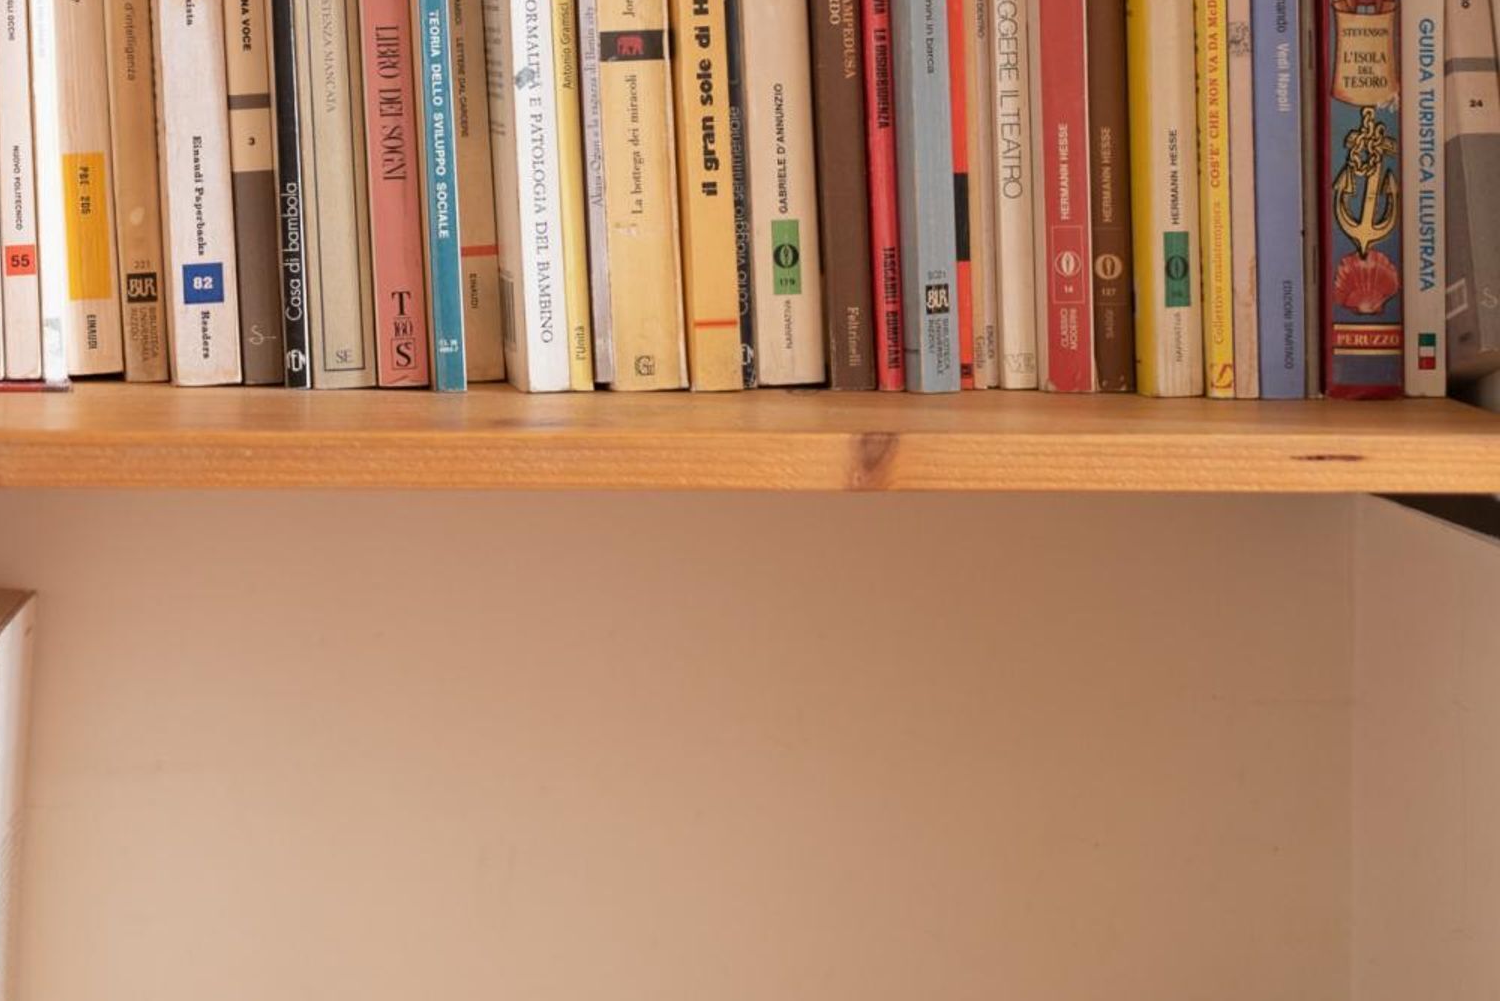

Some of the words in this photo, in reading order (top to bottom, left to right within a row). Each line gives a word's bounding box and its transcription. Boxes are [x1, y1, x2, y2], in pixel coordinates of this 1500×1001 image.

[241, 20, 252, 51] VOCE
[375, 26, 401, 78] LIBRO
[428, 11, 441, 57] TEORIA
[696, 27, 712, 49] di
[1342, 28, 1389, 37] STEVENSON
[1418, 19, 1434, 81] GUIDA
[1277, 43, 1289, 69] Vedi
[1343, 52, 1386, 64] L'ISOLA
[379, 89, 403, 117] DEI
[430, 64, 443, 106] DELLO
[529, 98, 542, 106] E
[697, 59, 714, 105] sole
[1000, 90, 1020, 106] IL
[1277, 73, 1290, 112] Napoli
[1343, 76, 1388, 88] TESORO
[774, 84, 785, 154] D'ANNUNZIO
[1418, 90, 1435, 182] TURISTICA
[192, 136, 203, 183] Einaudi
[381, 126, 406, 181] SOGNI
[432, 113, 446, 175] SVILUPPO
[529, 113, 547, 214] PATOLOGIA
[700, 116, 717, 171] gran
[1000, 109, 1023, 199] TEATRO
[703, 182, 718, 196] il
[777, 159, 787, 214] GABRIELE
[194, 188, 206, 256] Paperbacks
[280, 183, 302, 251] bambola
[435, 183, 448, 238] SOCIALE
[11, 255, 30, 267] 55
[535, 222, 549, 254] DEL
[1418, 191, 1435, 291] ILLUSTRATA
[193, 276, 213, 289] 82
[280, 259, 303, 273] di
[285, 279, 303, 320] Casa
[536, 262, 553, 343] BAMBINO
[201, 311, 212, 359] Readers
[848, 307, 861, 366] Feltrinelli
[1336, 334, 1399, 344] PERUZZO
